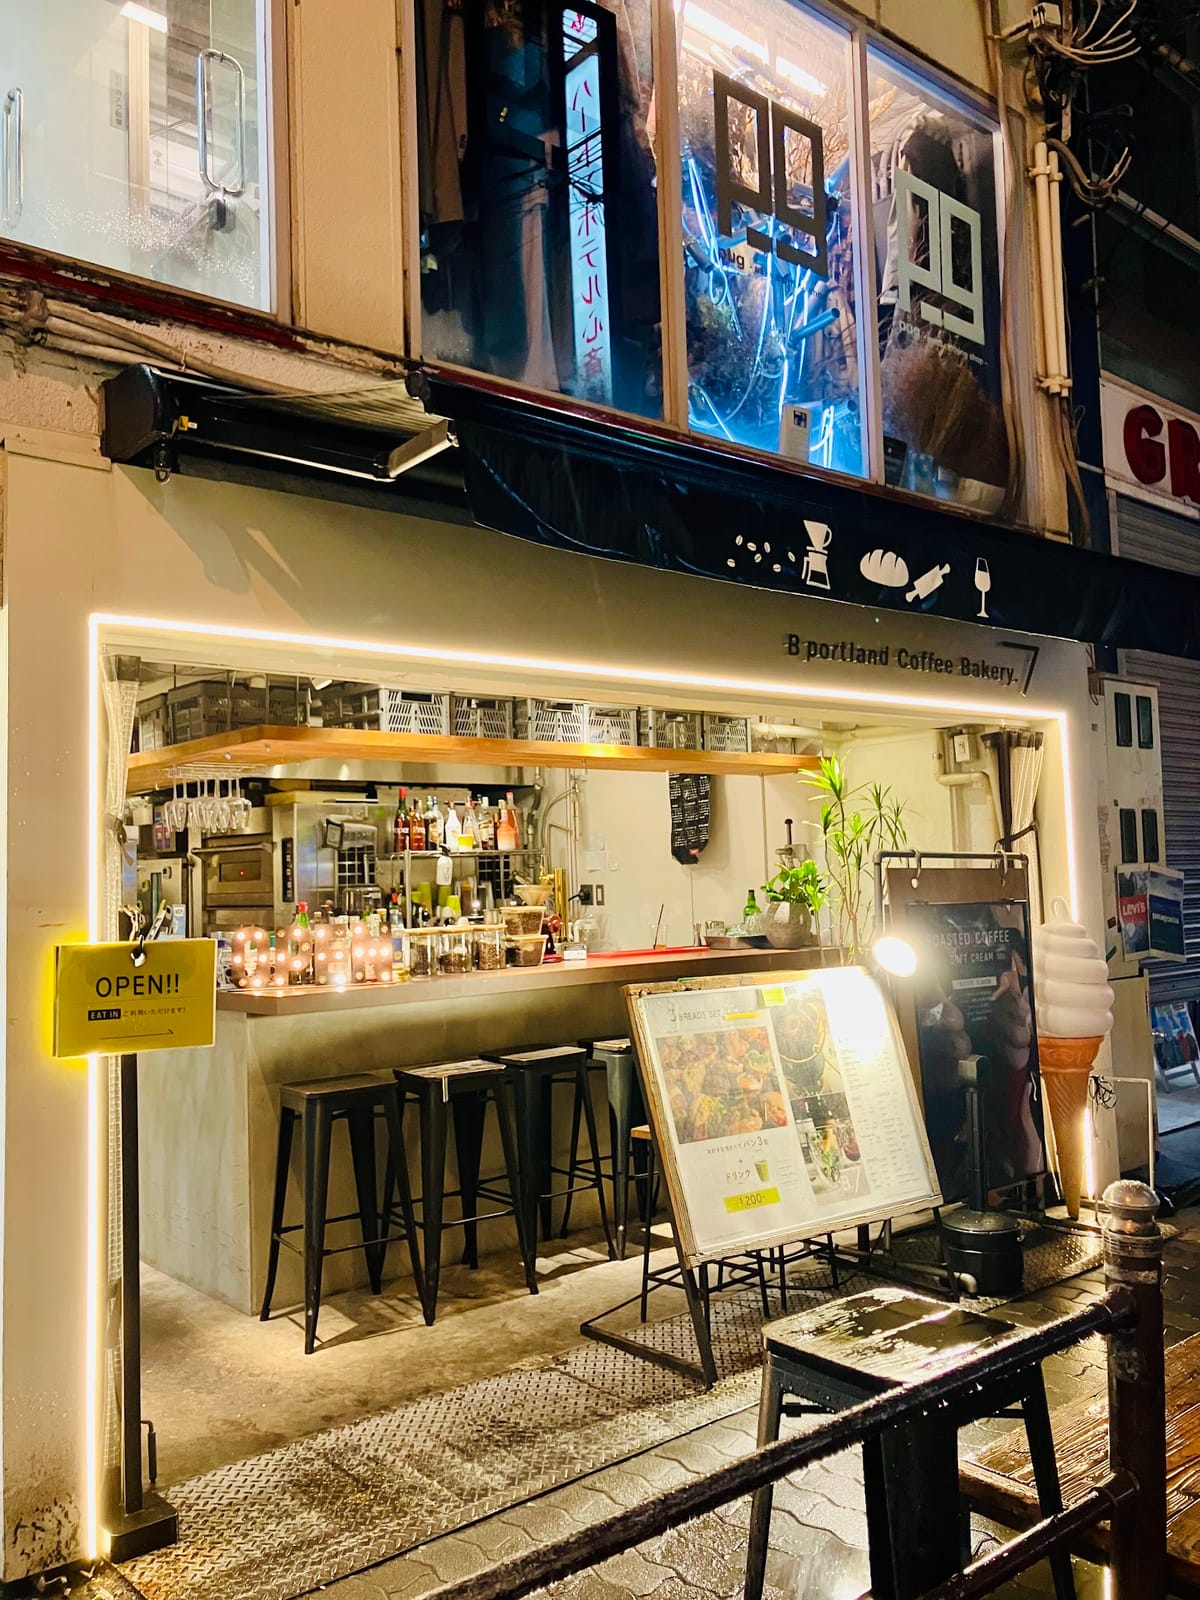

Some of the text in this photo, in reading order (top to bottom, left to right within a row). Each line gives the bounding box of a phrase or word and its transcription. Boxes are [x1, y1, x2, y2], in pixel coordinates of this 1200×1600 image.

[787, 633, 800, 656] B
[806, 640, 889, 666] portland
[896, 647, 953, 675] Coffee
[928, 930, 1010, 946] OASTED COFFEE
[970, 951, 994, 962] CREAM
[96, 973, 180, 998] OPEN!!
[90, 1011, 108, 1020] EAT
[109, 1010, 120, 1019] IN
[678, 1010, 706, 1022] BREADS
